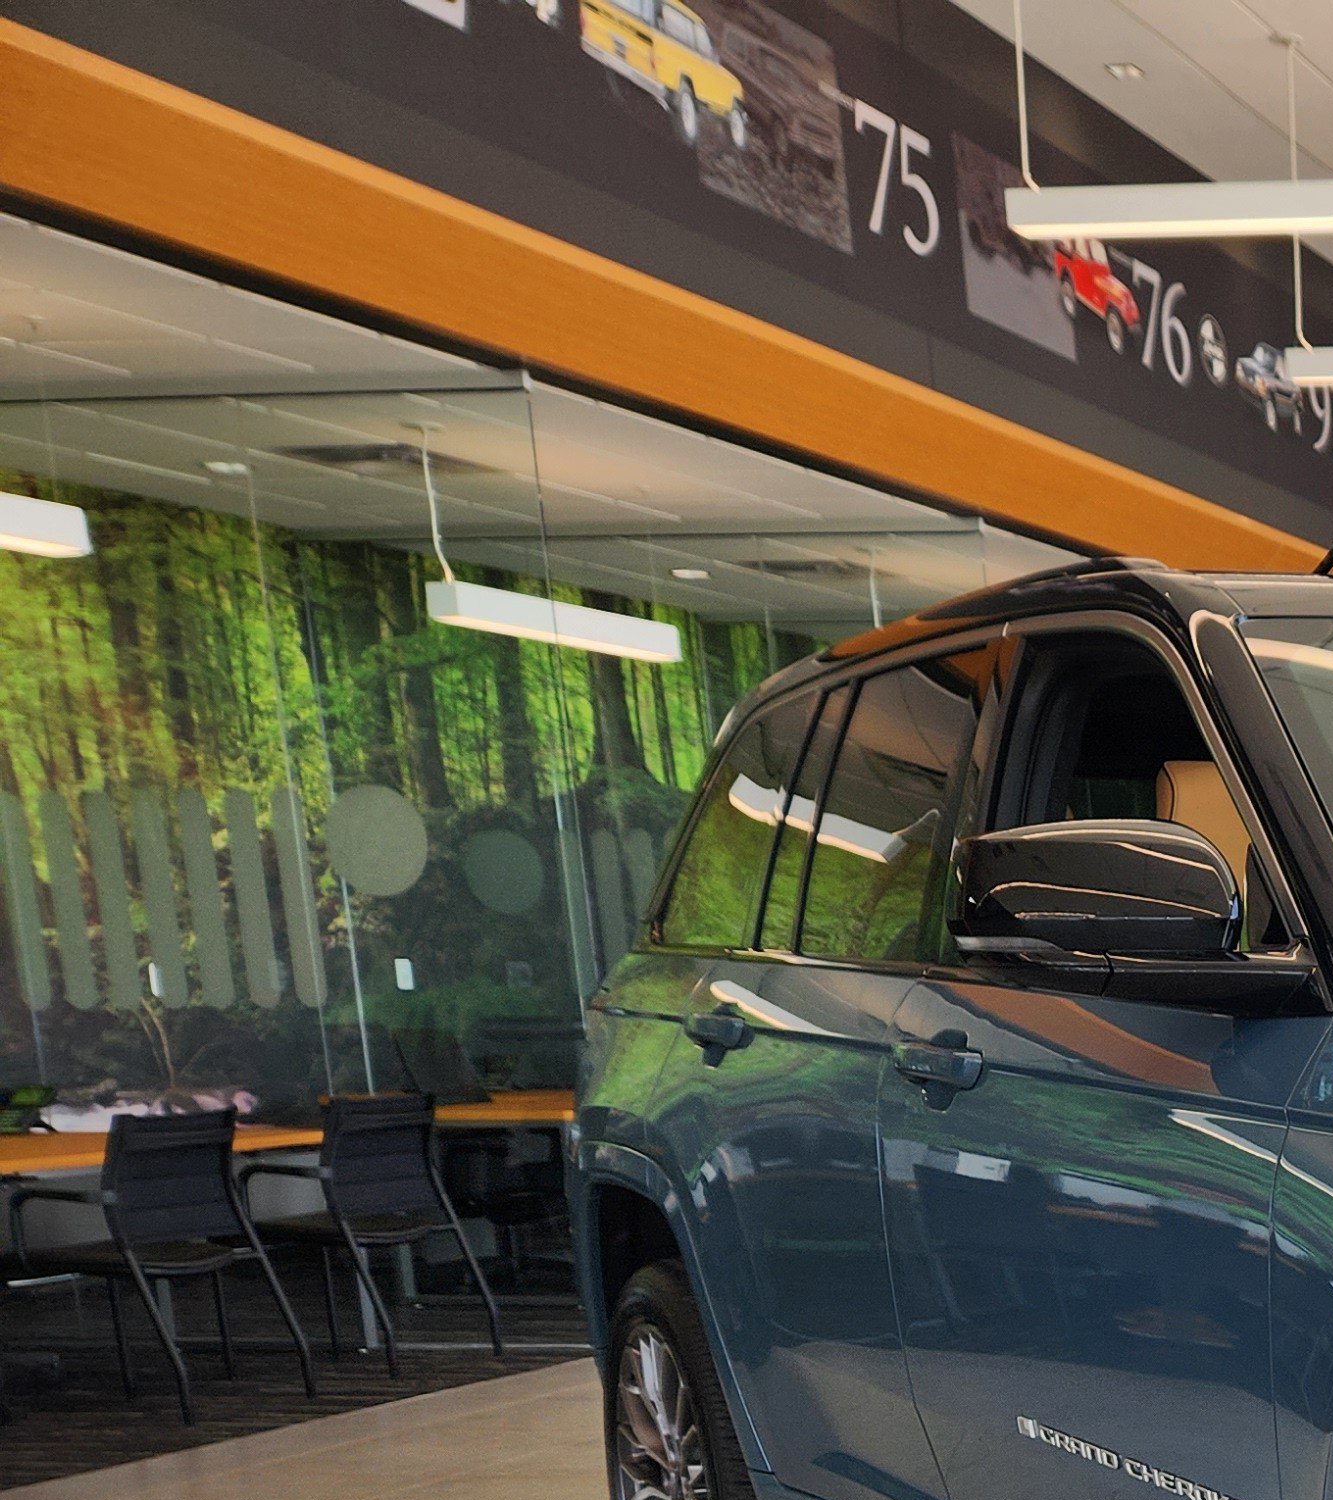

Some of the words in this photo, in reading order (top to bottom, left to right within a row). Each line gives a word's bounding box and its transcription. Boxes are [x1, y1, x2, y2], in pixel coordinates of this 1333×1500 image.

[855, 98, 940, 257] 75
[1132, 256, 1192, 388] 76
[1039, 1424, 1120, 1470] GRAND
